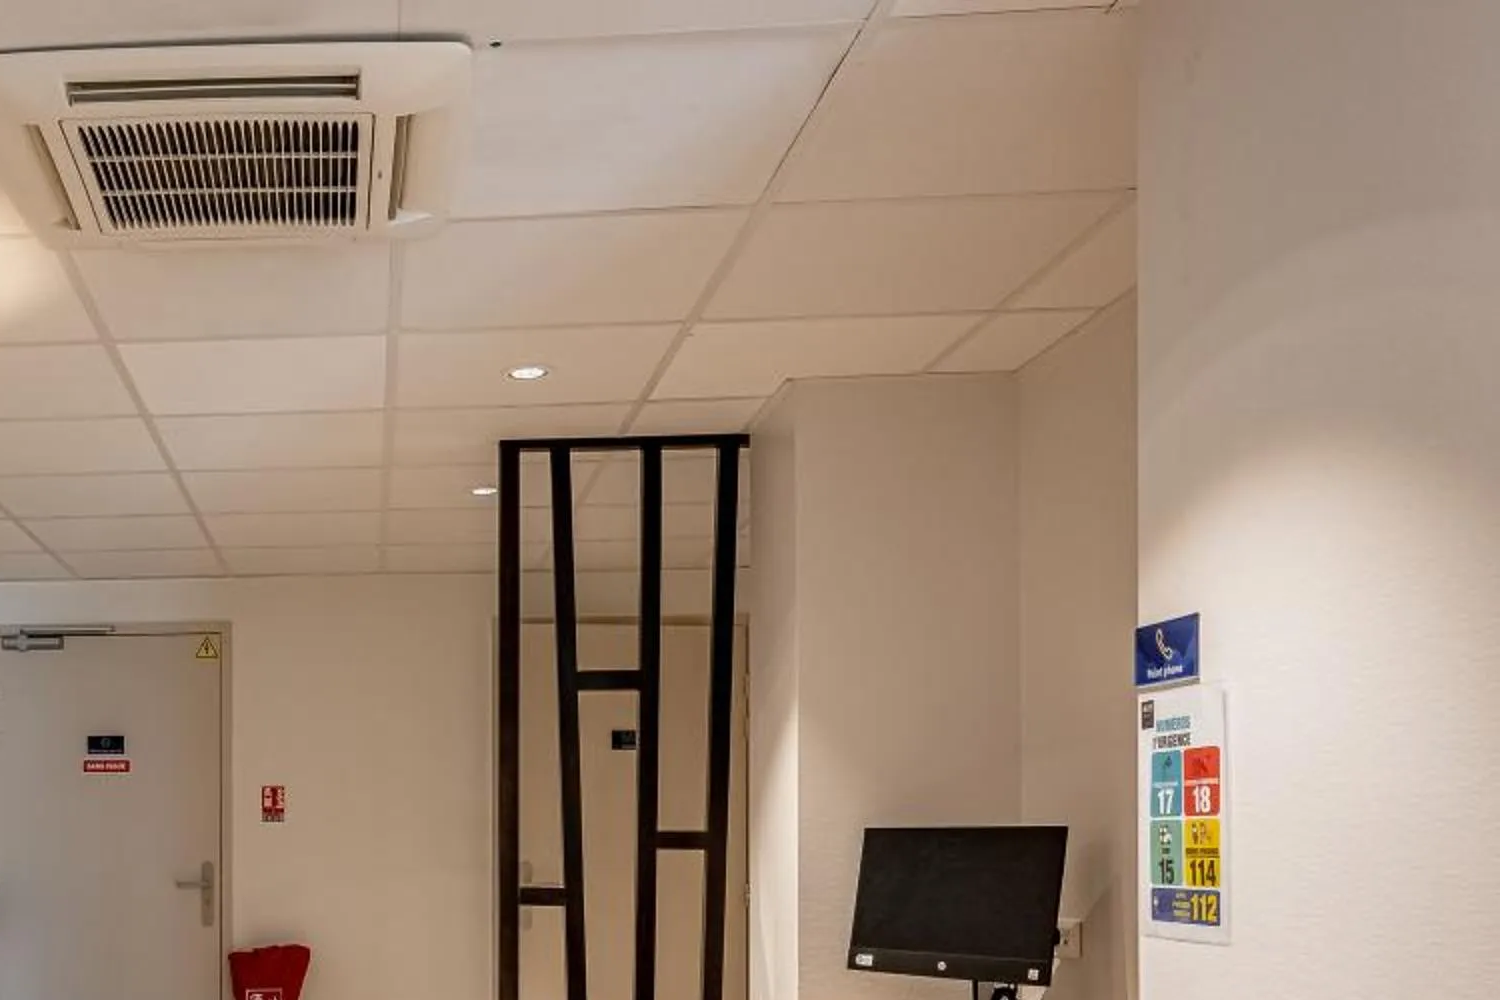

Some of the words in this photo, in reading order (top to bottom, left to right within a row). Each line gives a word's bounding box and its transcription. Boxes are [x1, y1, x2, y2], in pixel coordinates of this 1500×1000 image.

[1157, 788, 1174, 815] 17
[1192, 785, 1211, 813] 18
[1159, 857, 1175, 884] 15
[1190, 858, 1217, 887] 114
[1190, 892, 1217, 922] 112
